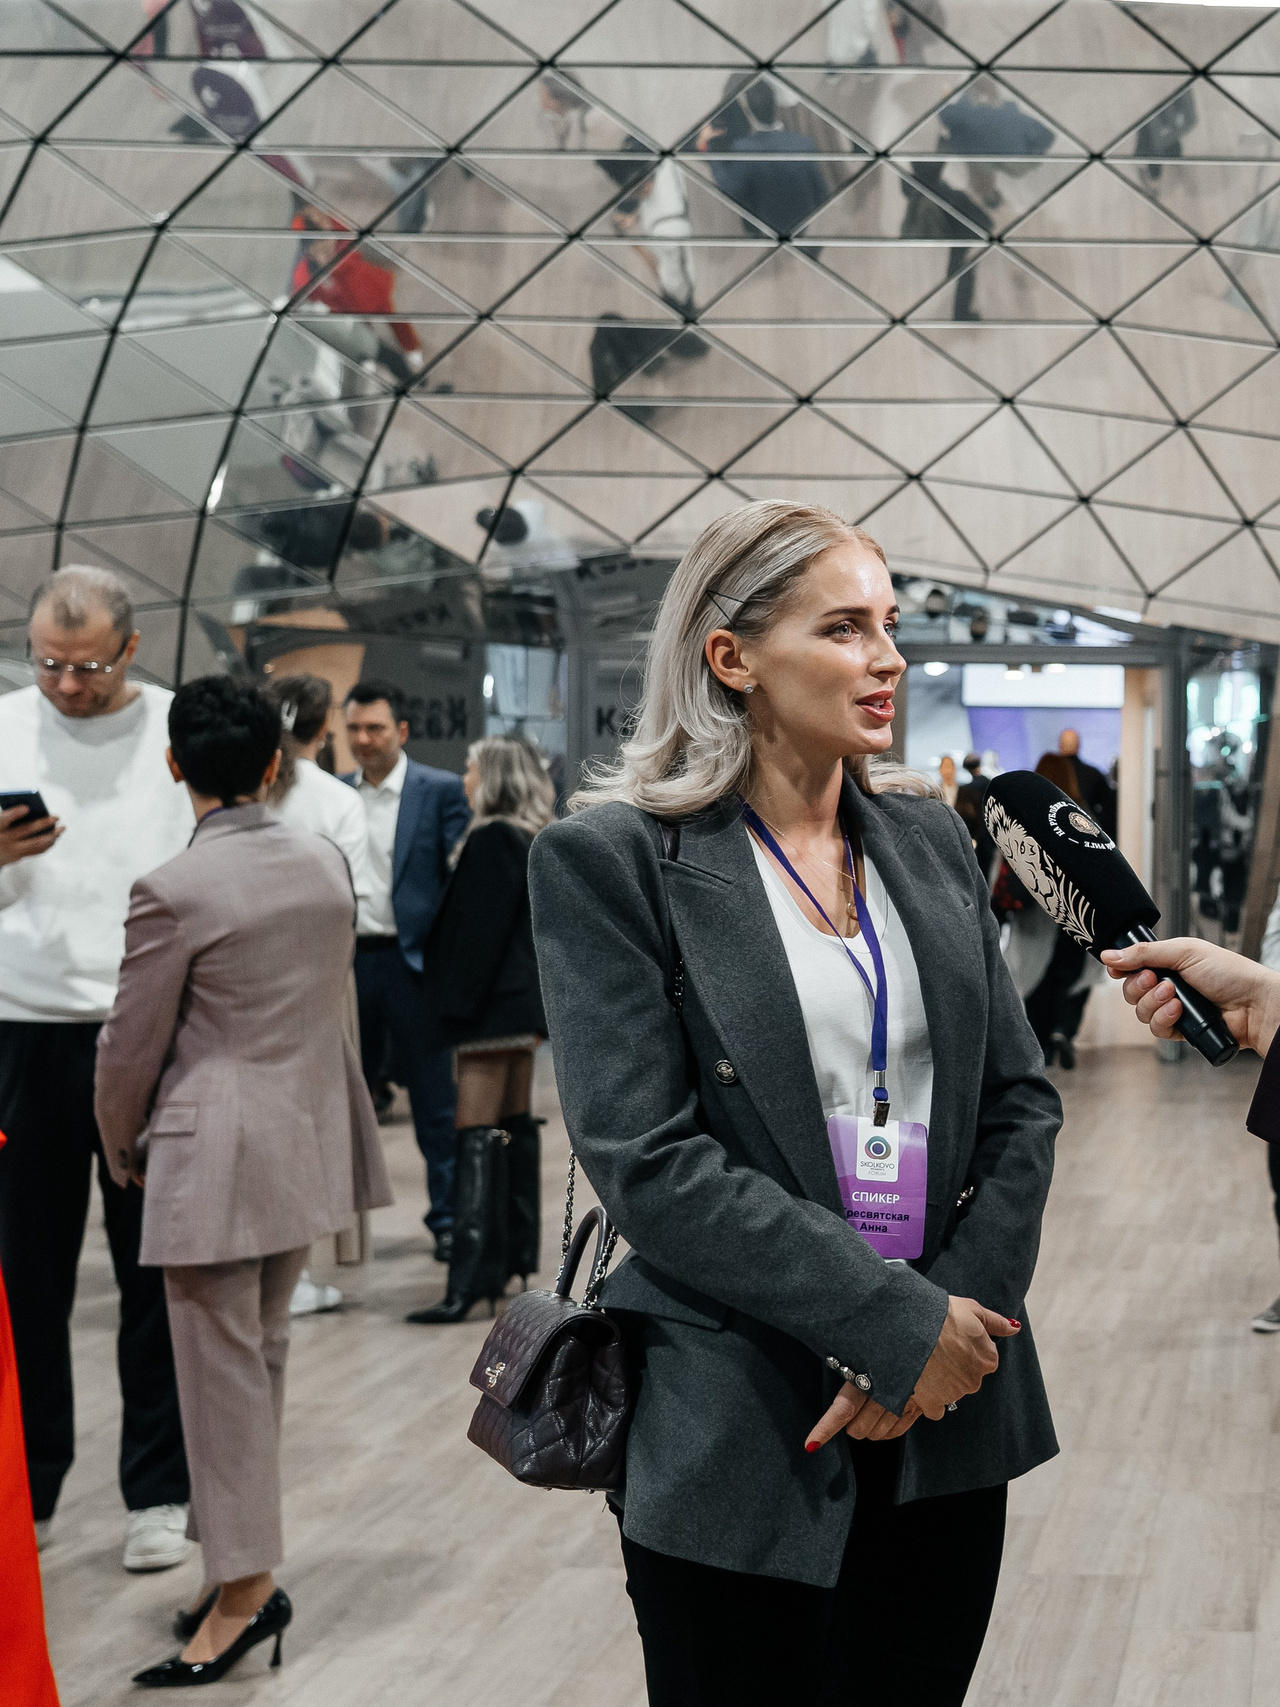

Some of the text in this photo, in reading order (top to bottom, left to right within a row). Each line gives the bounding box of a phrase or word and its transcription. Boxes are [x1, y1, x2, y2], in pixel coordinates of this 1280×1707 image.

[1053, 826, 1065, 837] НА
[860, 1160, 895, 1170] SKOLKOVO
[852, 1191, 899, 1203] СПИКЕР
[844, 1207, 909, 1221] ресвятская
[860, 1222, 887, 1232] Анна
